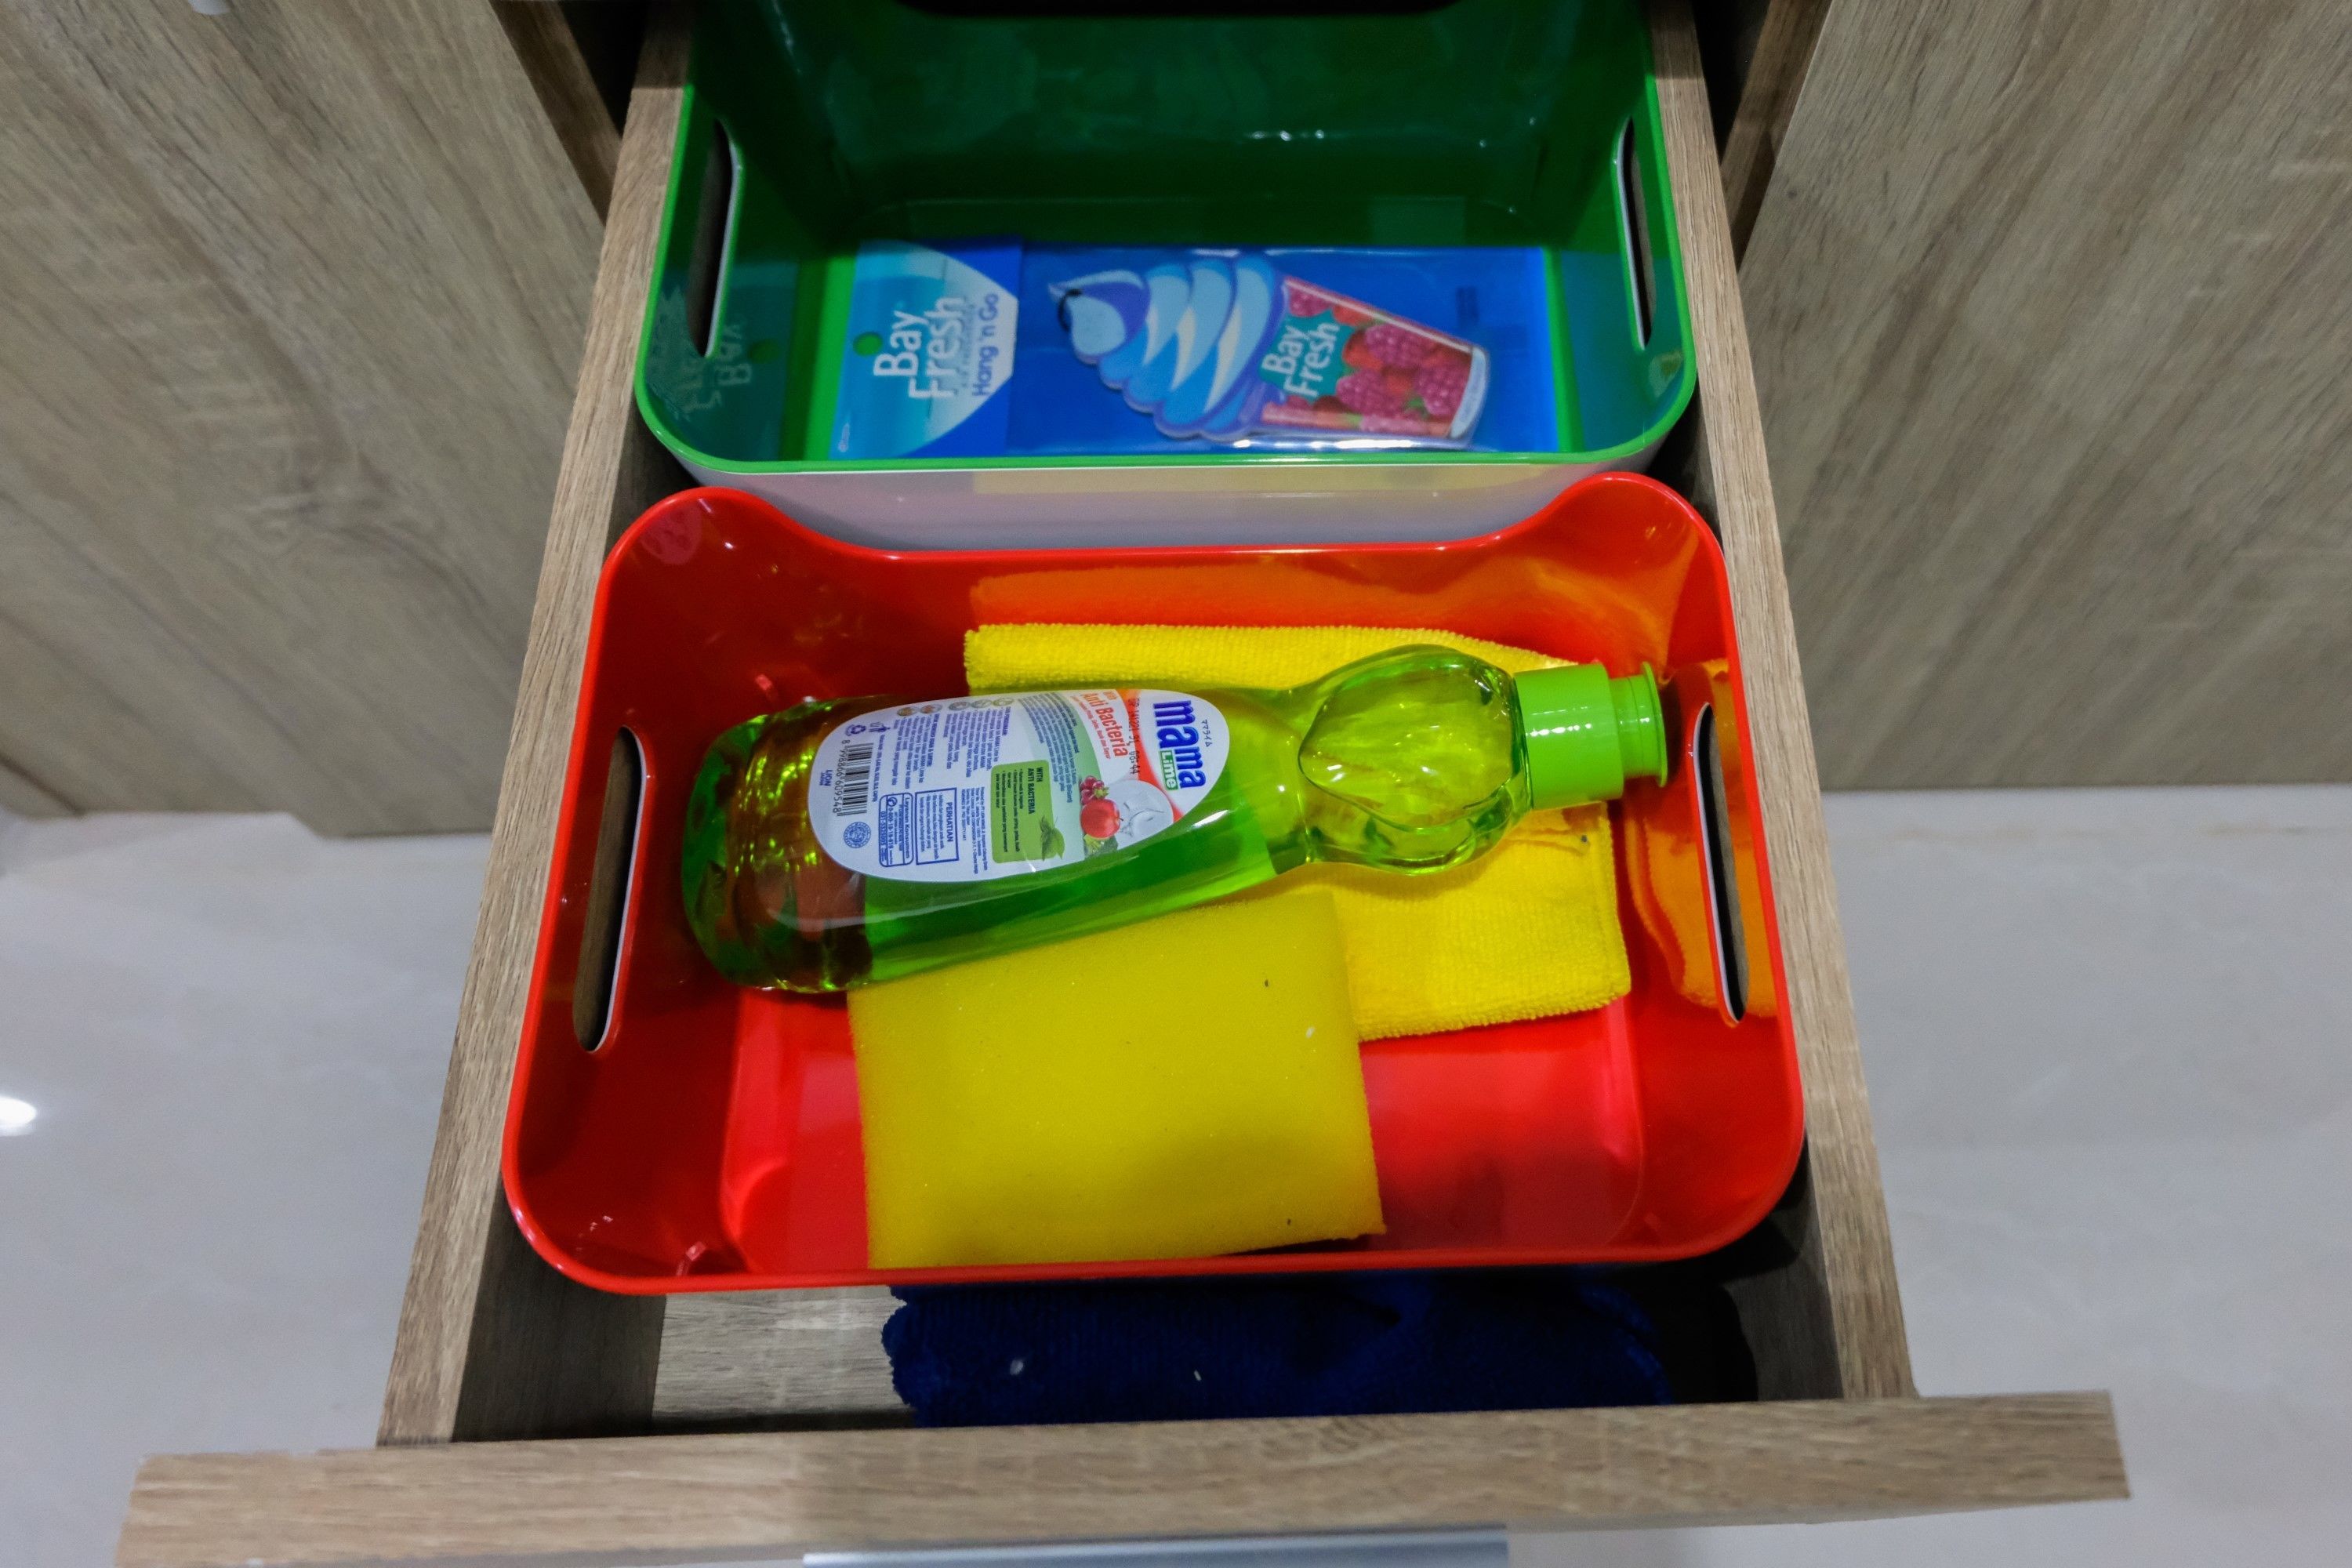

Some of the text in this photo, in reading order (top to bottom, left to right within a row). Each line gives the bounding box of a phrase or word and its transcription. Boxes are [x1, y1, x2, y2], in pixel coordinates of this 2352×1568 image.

[978, 294, 999, 321] Go
[873, 310, 931, 376] Bay
[909, 297, 963, 399] Fresh
[1259, 325, 1309, 375] Bay
[1282, 323, 1340, 397] Fresh
[971, 347, 999, 397] Hang
[1080, 693, 1129, 757] Anti Bacteria
[1153, 700, 1207, 789] mama
[835, 749, 848, 777] 998866
[1161, 751, 1177, 789] Lime
[833, 780, 844, 814] 609548
